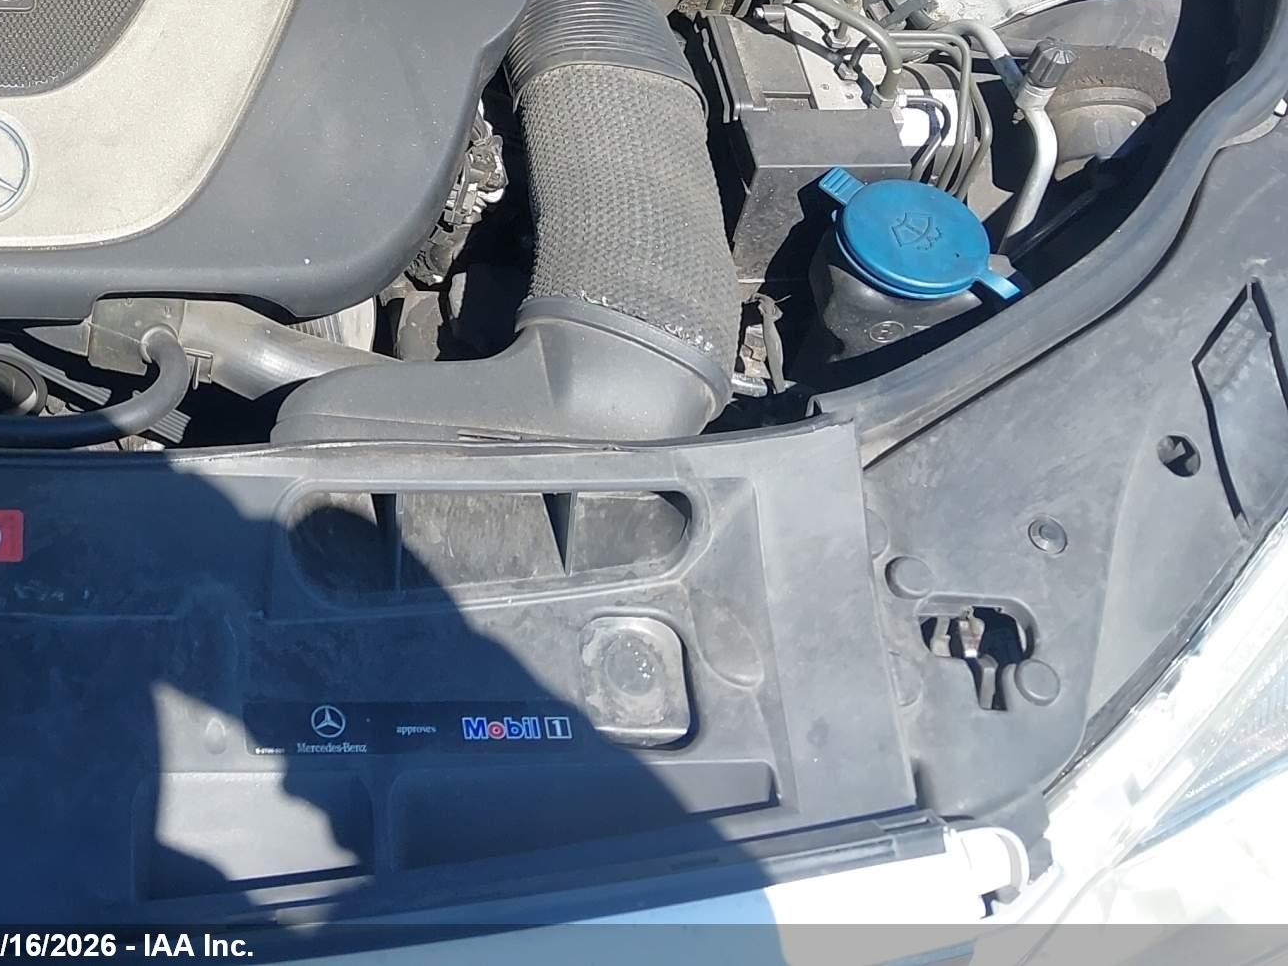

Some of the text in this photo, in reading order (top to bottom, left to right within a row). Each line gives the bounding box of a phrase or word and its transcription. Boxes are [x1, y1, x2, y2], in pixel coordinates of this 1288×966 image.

[396, 725, 436, 735] approves
[462, 716, 542, 740] Mobil
[296, 742, 367, 754] Mercedes-Benz
